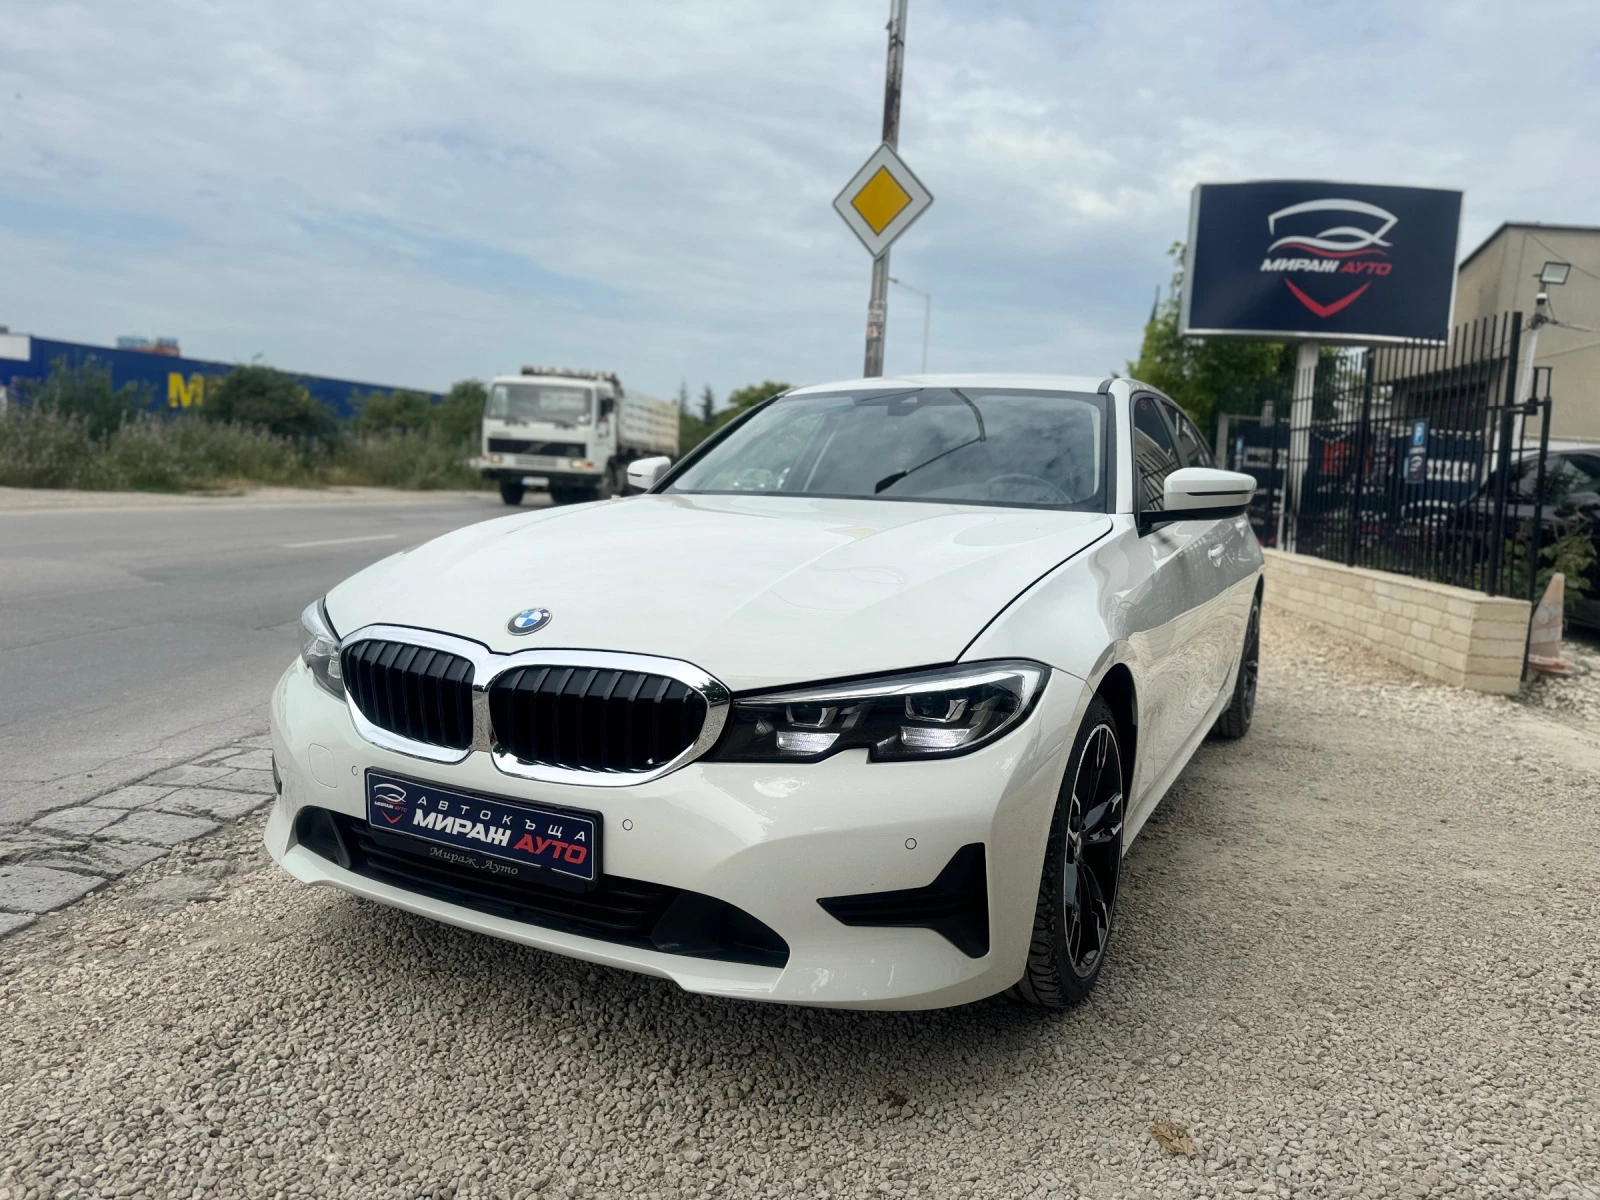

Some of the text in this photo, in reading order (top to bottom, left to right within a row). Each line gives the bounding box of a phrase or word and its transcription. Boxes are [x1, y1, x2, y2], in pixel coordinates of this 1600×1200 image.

[1260, 258, 1392, 276] МИРАЖ АУТО
[412, 808, 588, 865] МИРАЖ АУТО
[417, 796, 586, 842] АВТОКЪЩА
[430, 847, 519, 875] Мираж Ауто
